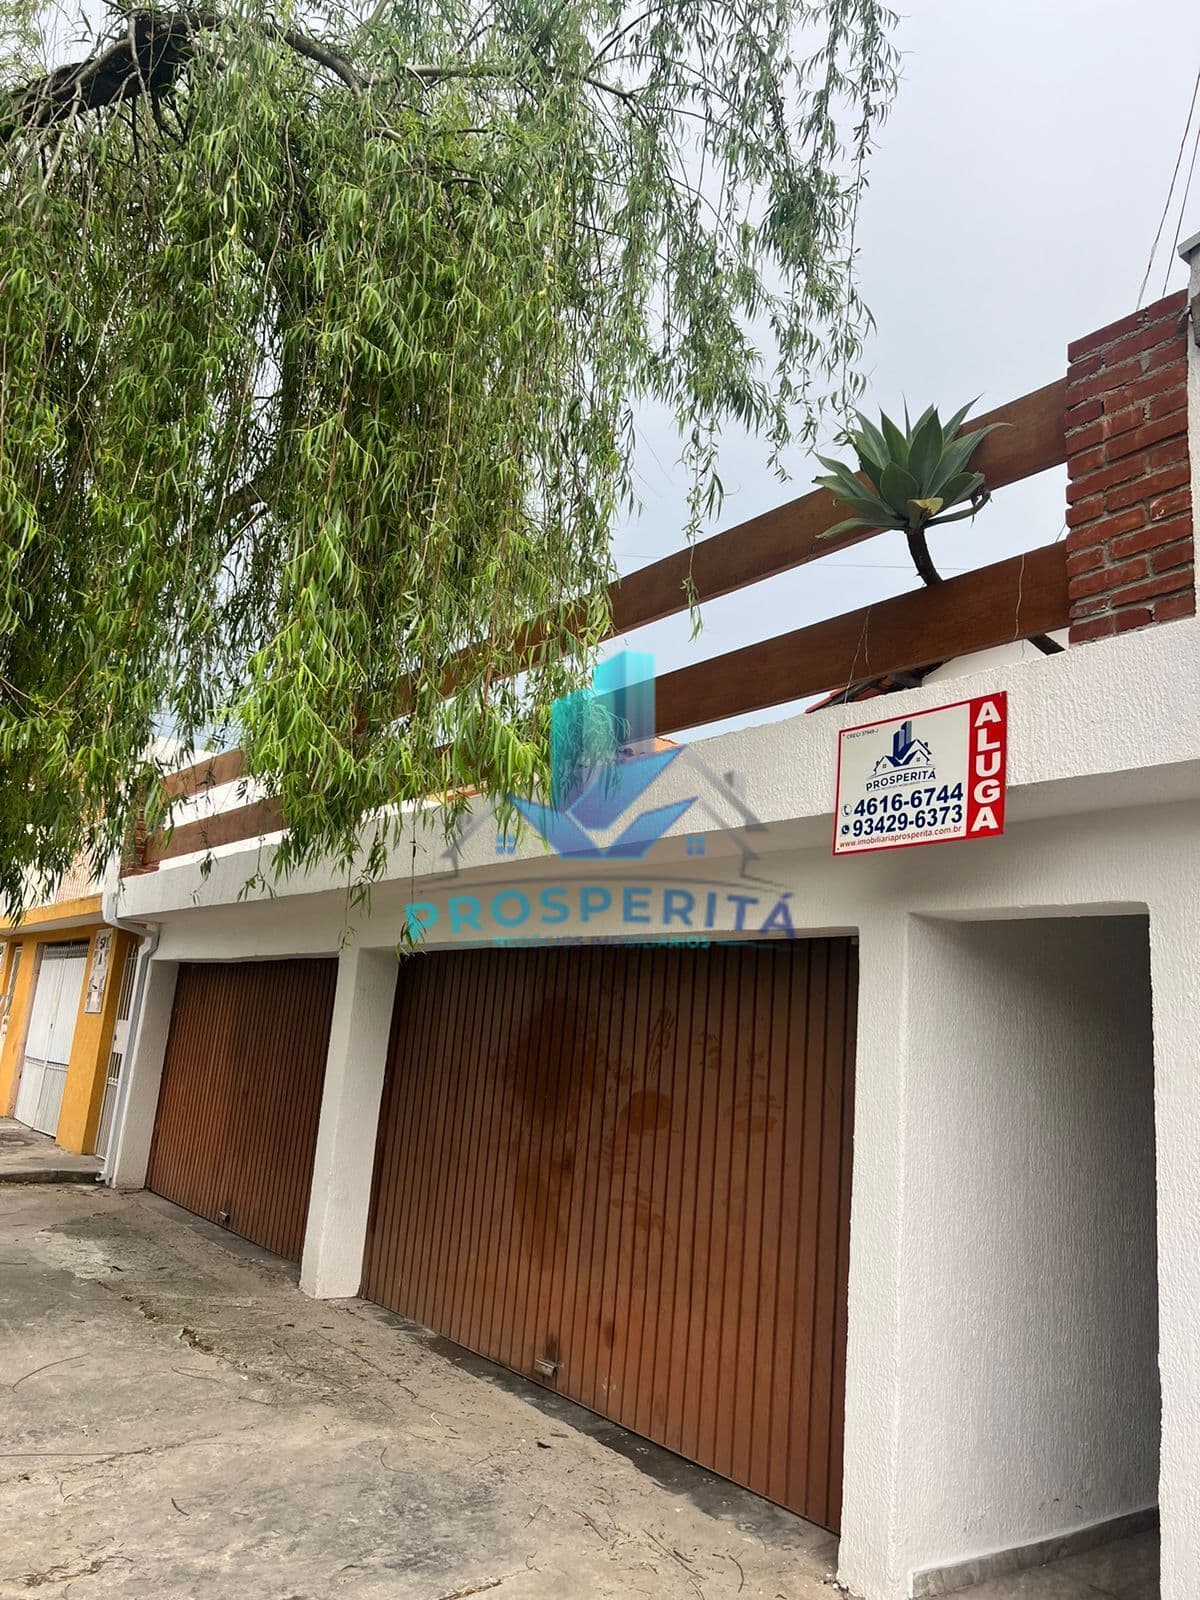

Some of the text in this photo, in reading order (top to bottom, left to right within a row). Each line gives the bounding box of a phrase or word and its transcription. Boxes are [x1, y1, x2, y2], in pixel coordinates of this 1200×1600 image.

[970, 701, 1002, 832] ALUGA
[853, 782, 963, 817] 4616-6744
[839, 825, 962, 848] www.imobiliariaprosperita.com.br
[853, 804, 963, 838] 93429-6373
